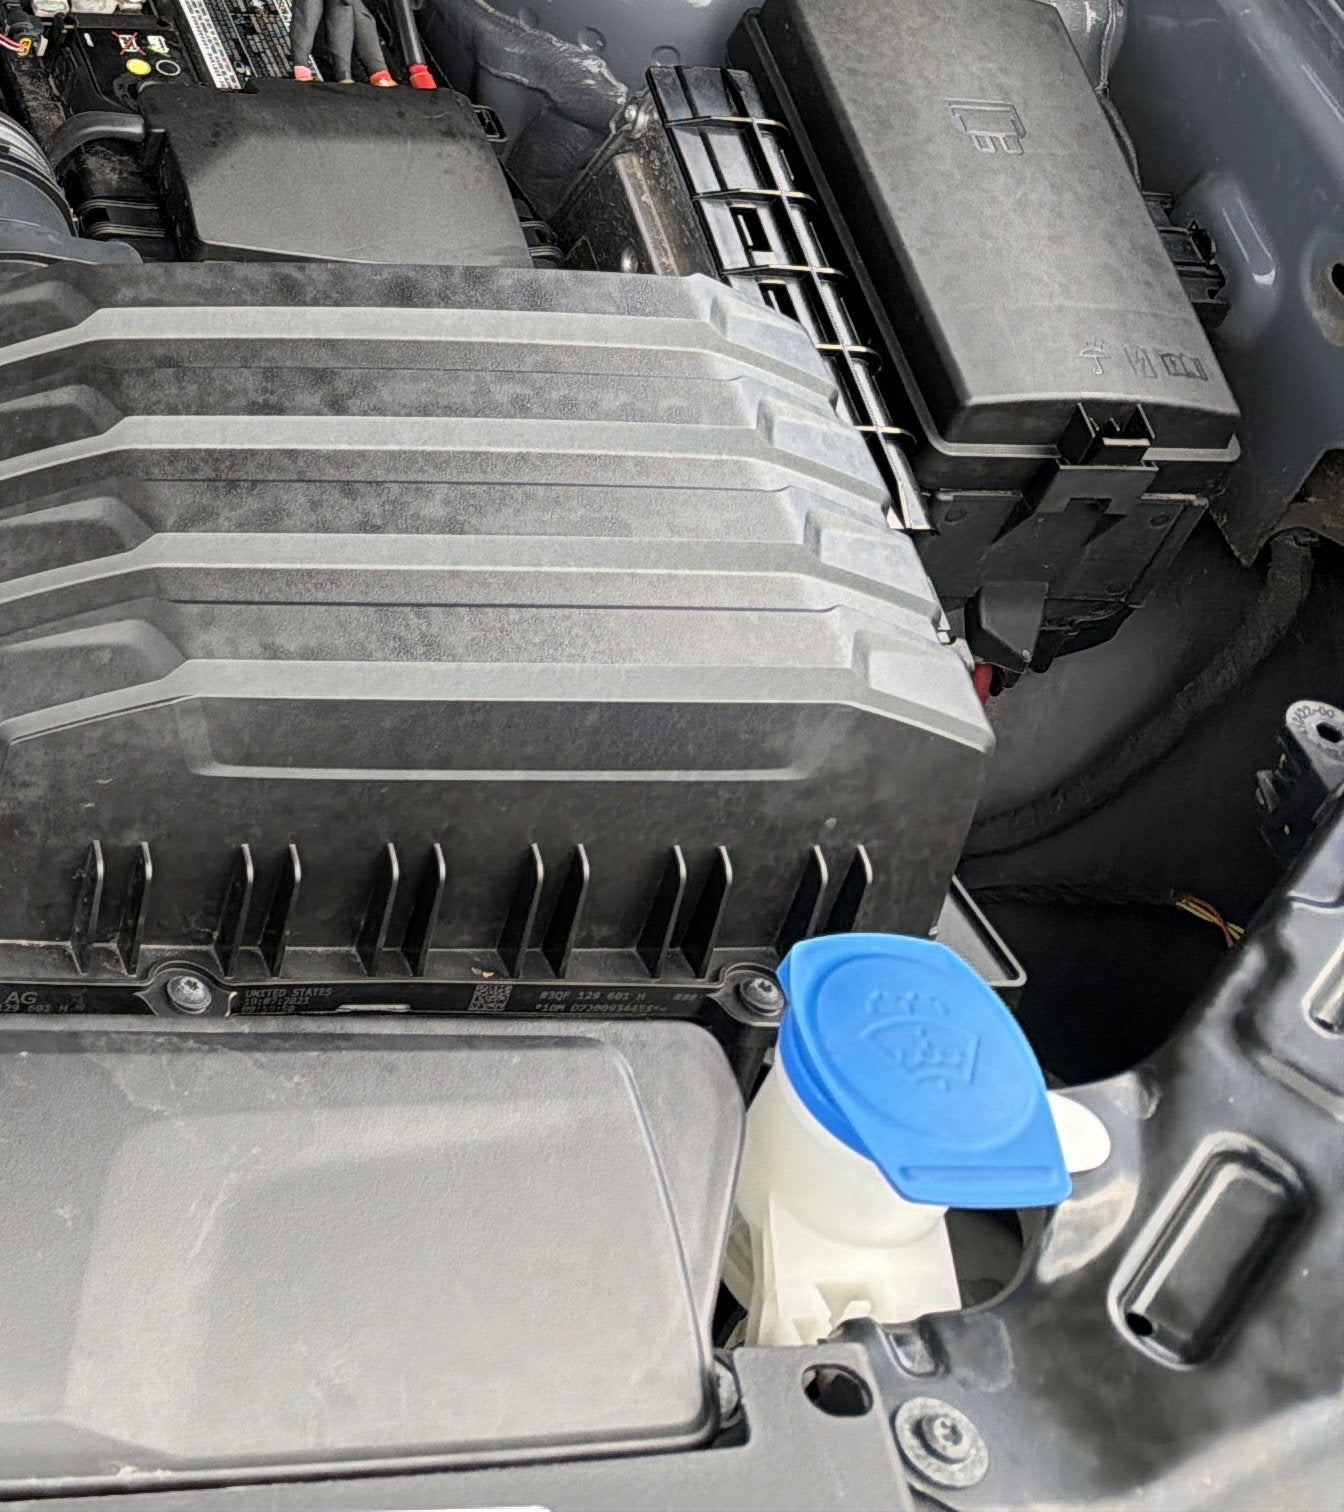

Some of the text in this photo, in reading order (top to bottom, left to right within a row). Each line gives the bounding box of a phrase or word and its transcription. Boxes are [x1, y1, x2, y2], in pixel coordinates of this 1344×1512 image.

[4, 991, 38, 1005] AG
[246, 988, 332, 998] UNITED STATES
